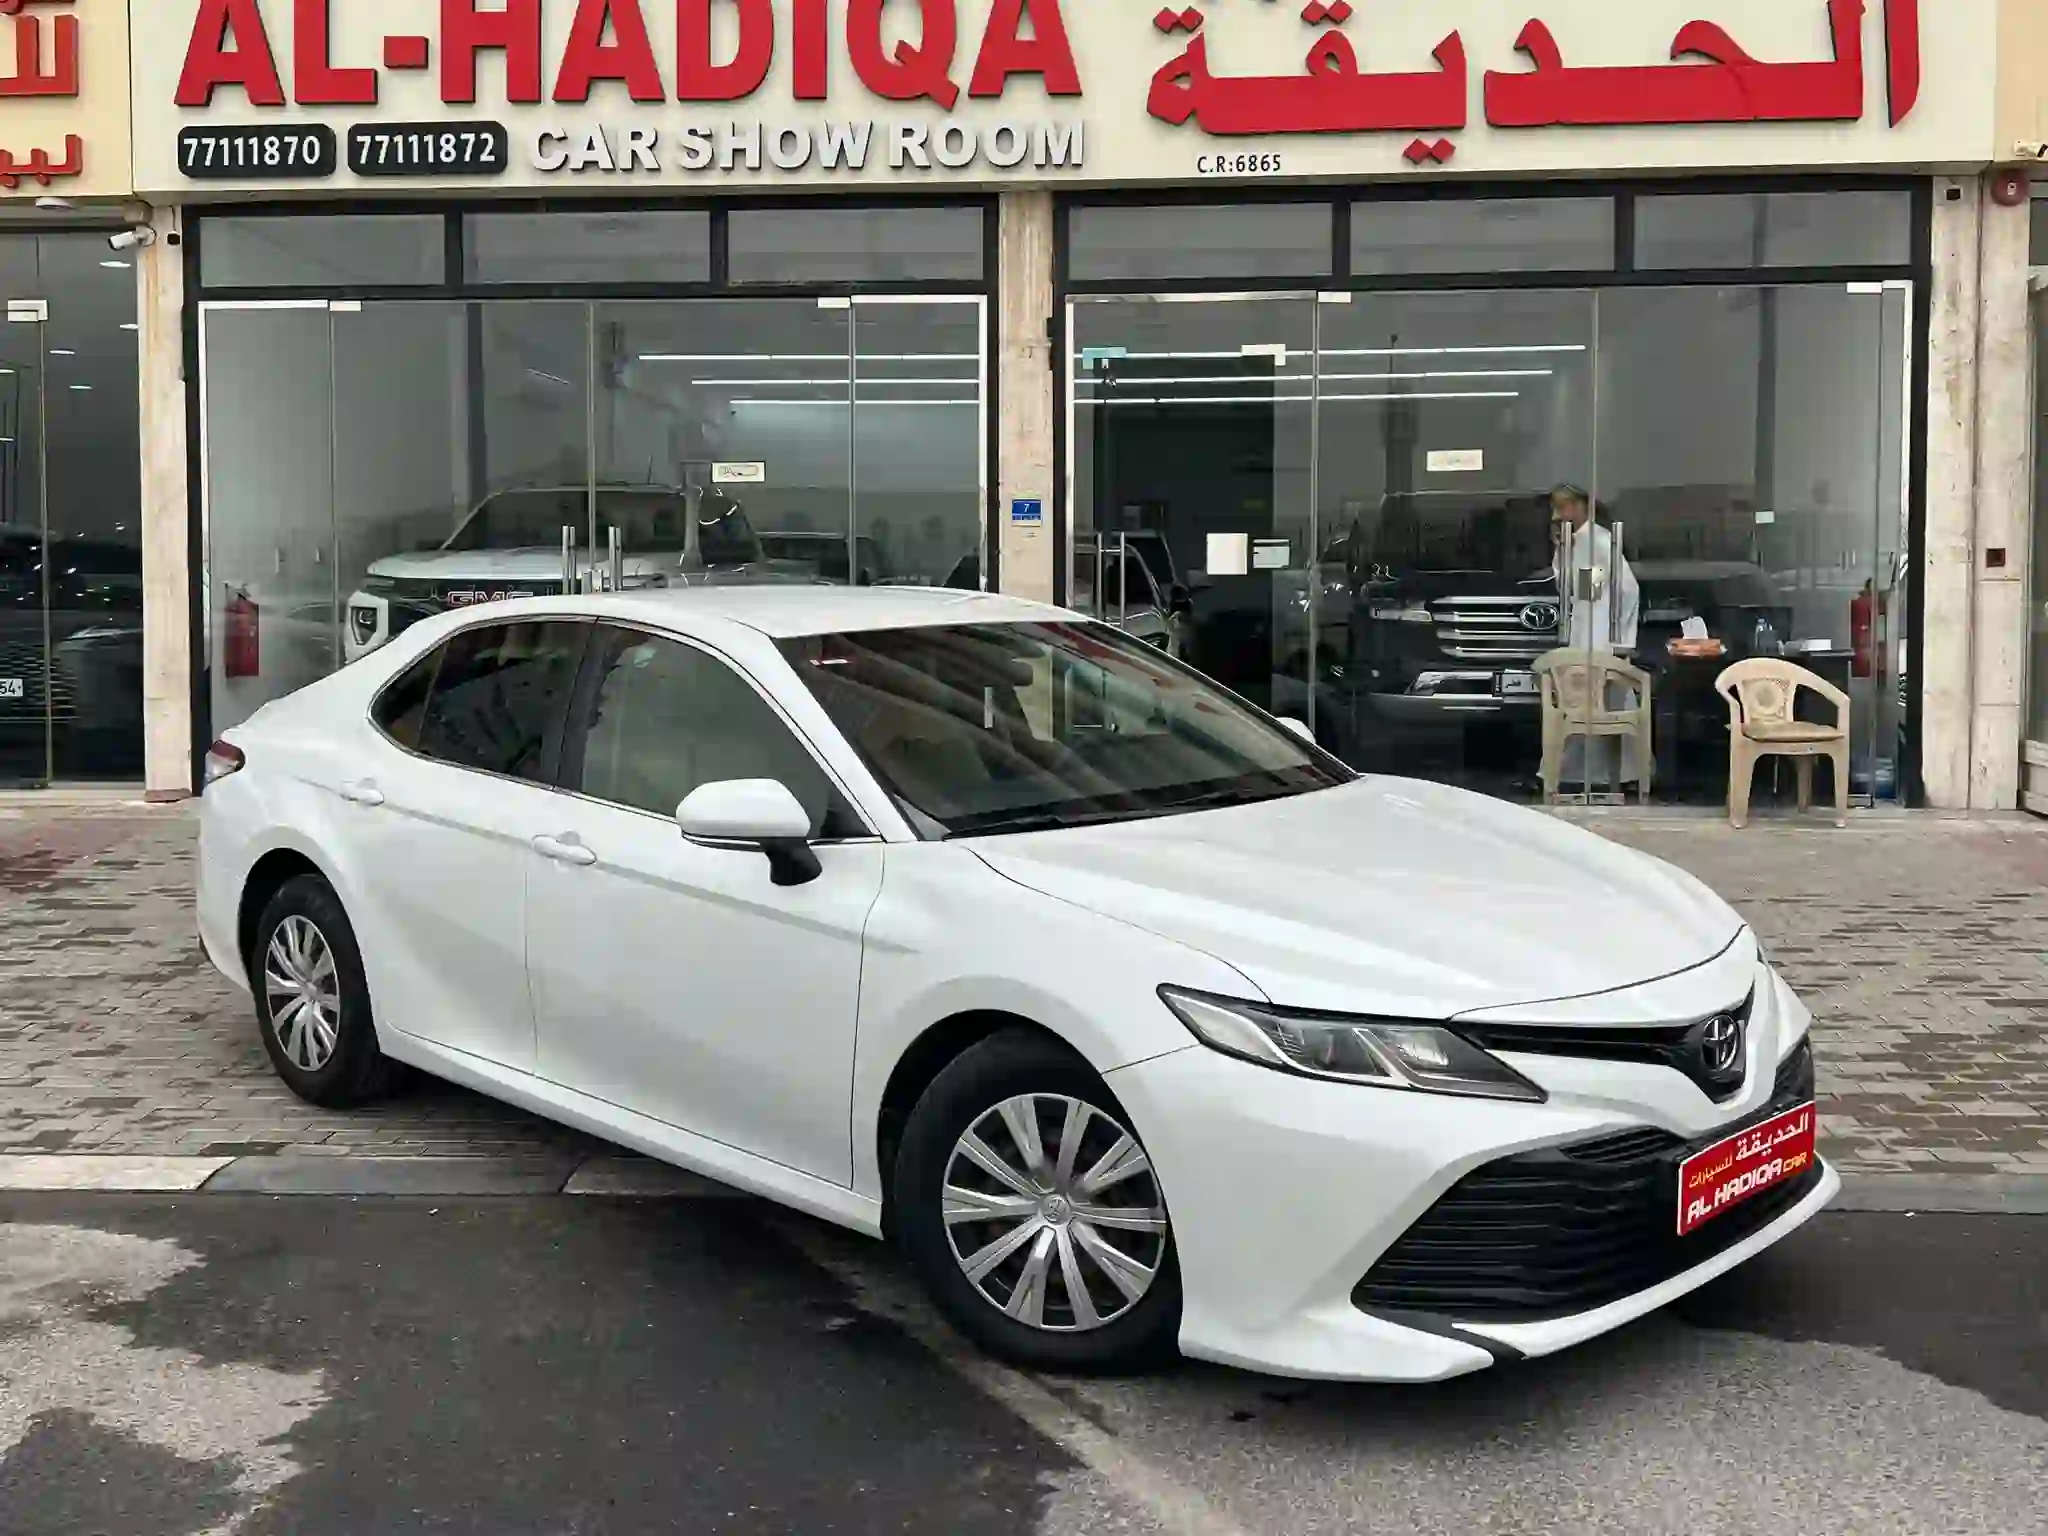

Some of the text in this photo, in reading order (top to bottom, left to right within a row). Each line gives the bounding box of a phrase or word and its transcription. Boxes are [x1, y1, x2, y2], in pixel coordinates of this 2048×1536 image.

[174, 0, 1082, 111] AL-HADIQA
[1147, 0, 1919, 165] الحديقة
[183, 136, 321, 167] 77111870
[355, 132, 497, 165] 77111872
[533, 118, 1085, 171] CAR SHOW ROOM
[1197, 154, 1281, 173] C.R:6865
[1736, 1113, 1808, 1160] الحديقة
